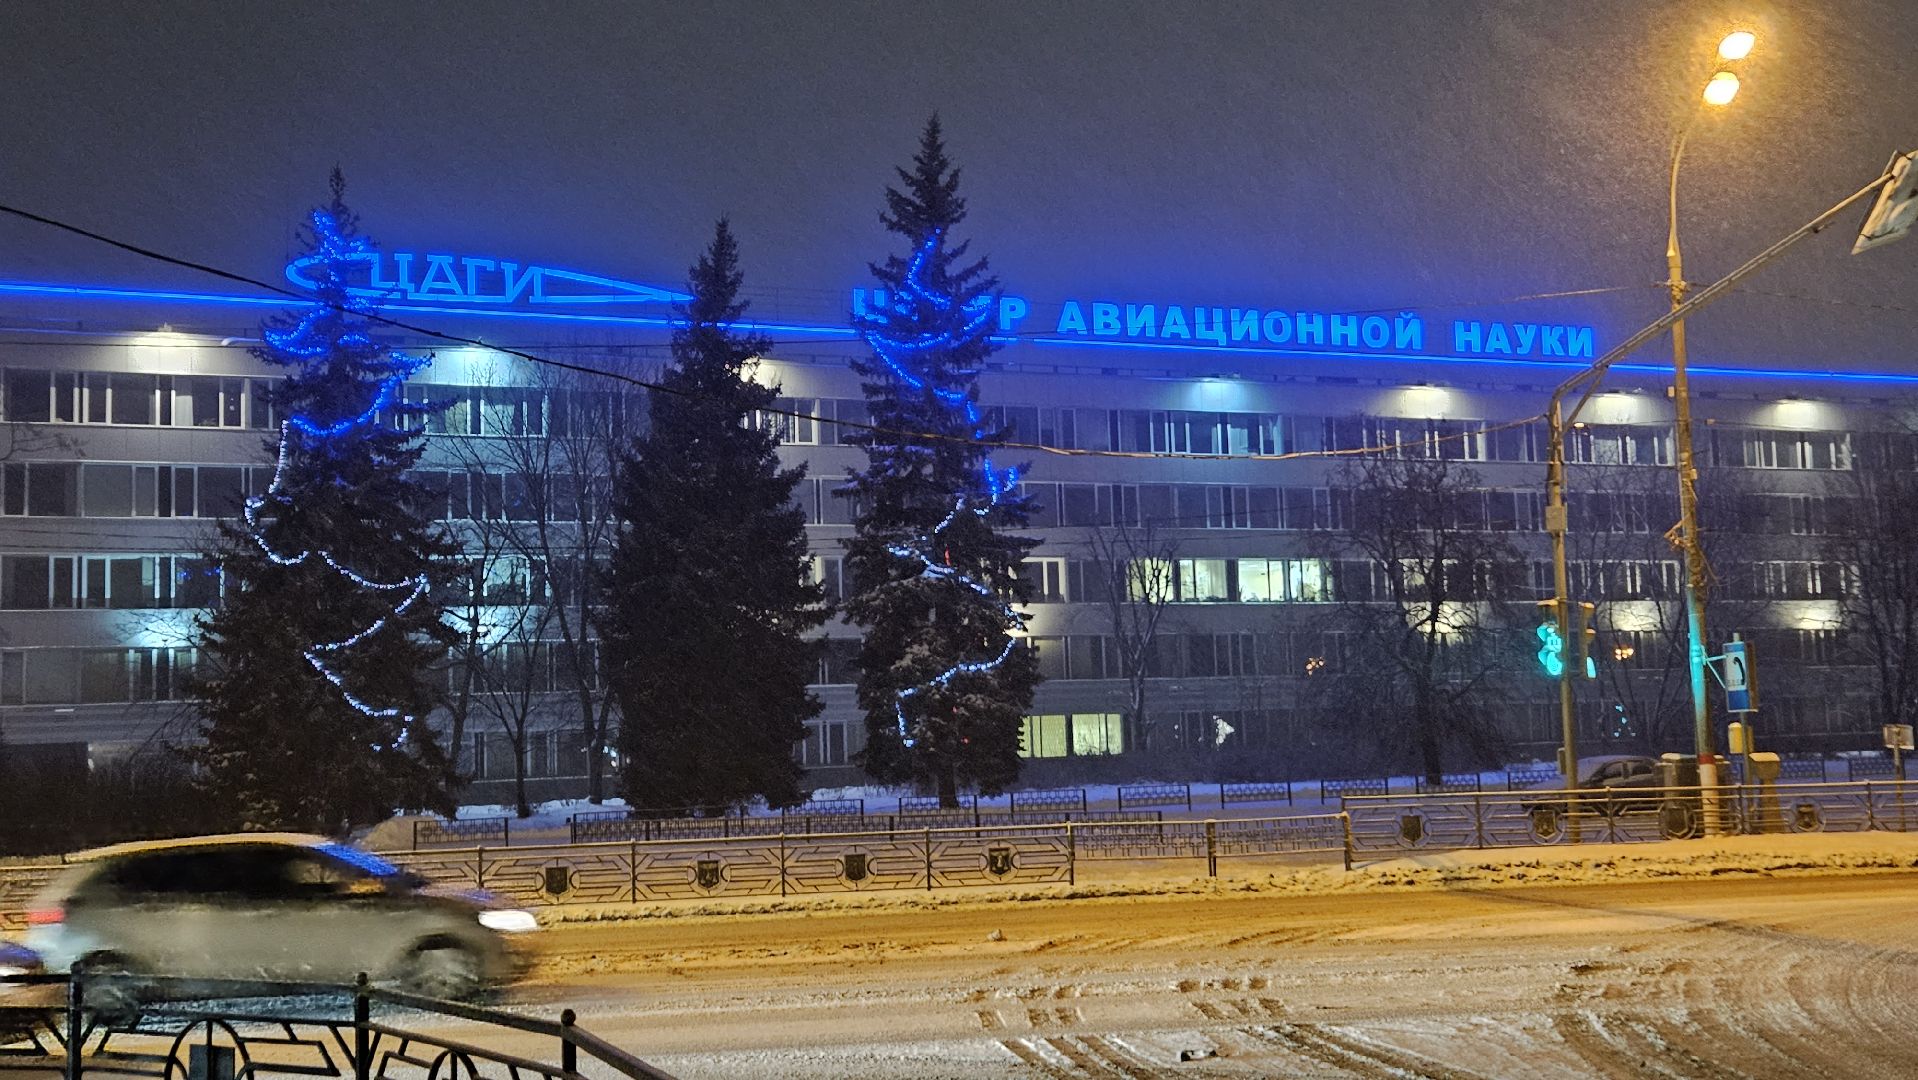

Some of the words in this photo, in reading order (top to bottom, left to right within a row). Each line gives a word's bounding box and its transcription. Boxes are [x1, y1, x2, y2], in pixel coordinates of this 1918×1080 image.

[364, 252, 546, 303] ЦАГИ
[1056, 300, 1423, 351] АВИАЦИОННОЙ
[1454, 319, 1593, 357] НАУКИ
